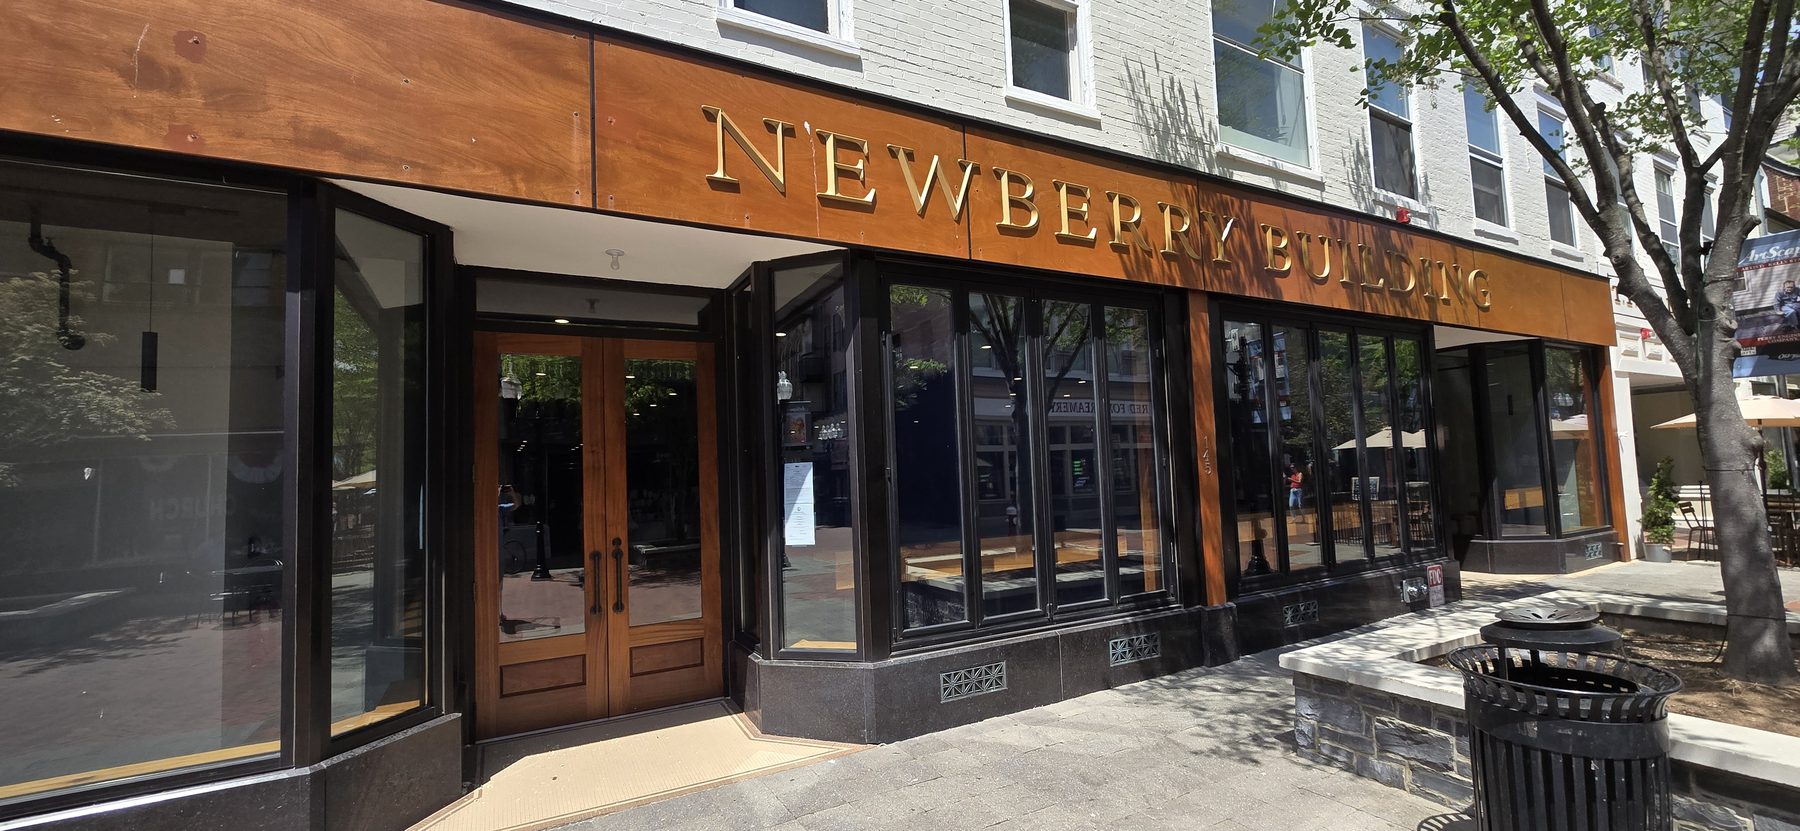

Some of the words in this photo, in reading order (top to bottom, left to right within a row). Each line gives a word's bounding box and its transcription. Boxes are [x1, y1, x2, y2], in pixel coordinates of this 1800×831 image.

[701, 104, 1238, 264] NEWBERRY
[1260, 223, 1491, 310] BUILDING
[1202, 435, 1212, 475] 145
[1428, 569, 1442, 585] FDC
